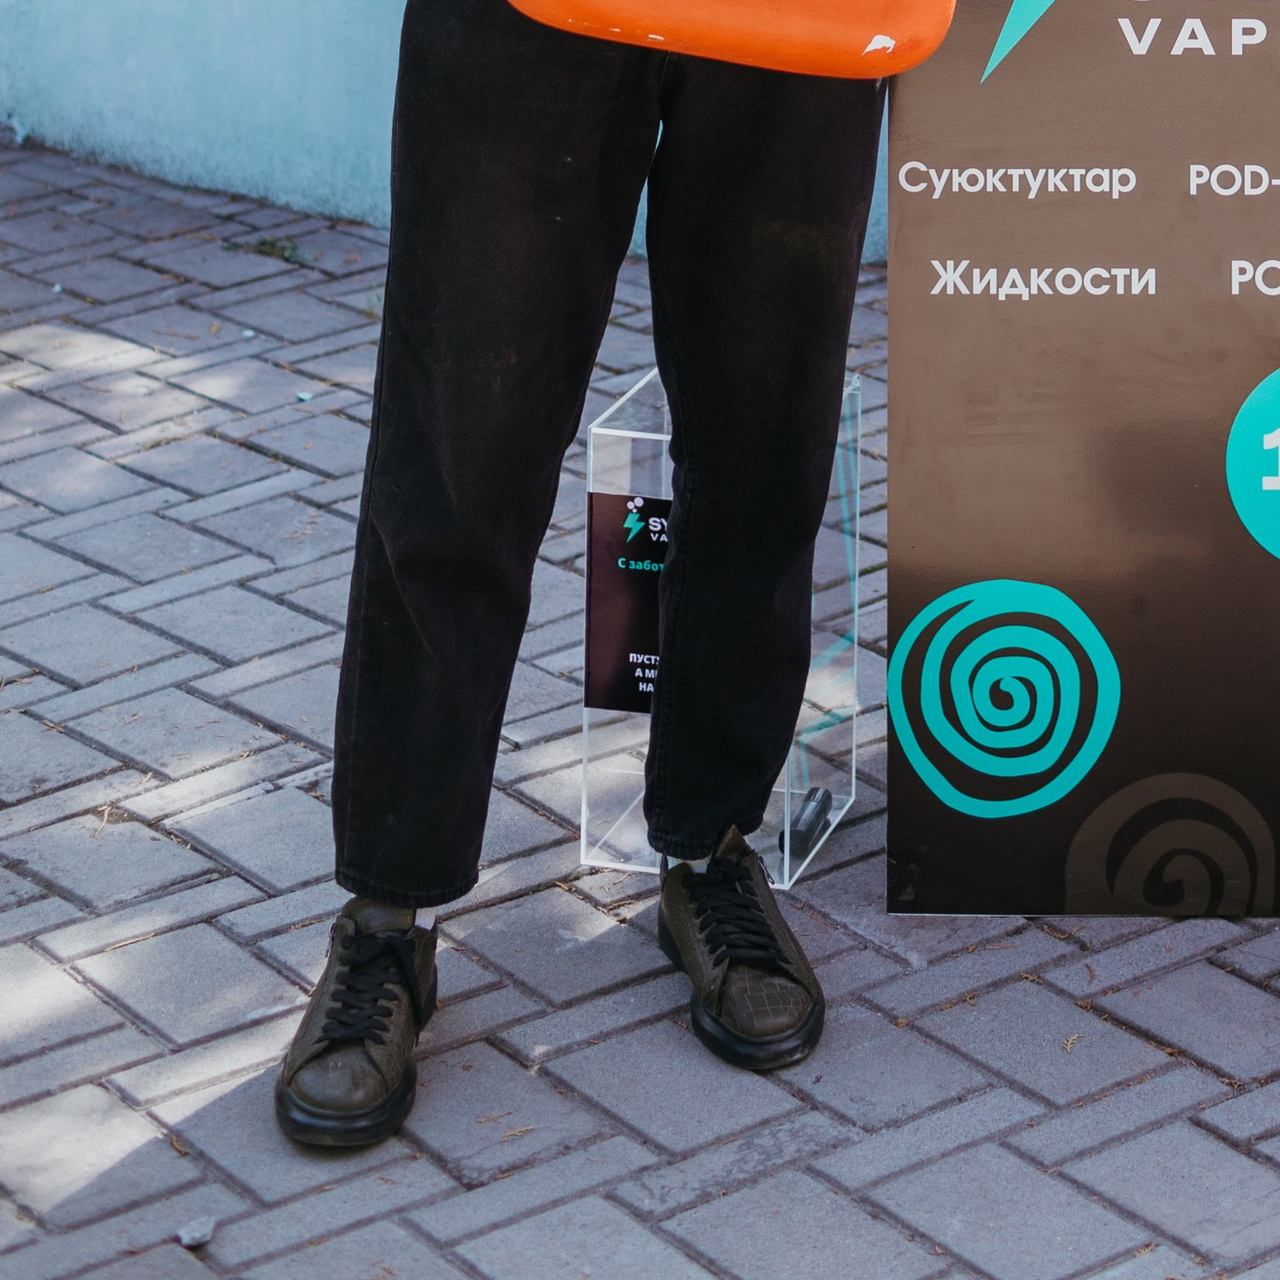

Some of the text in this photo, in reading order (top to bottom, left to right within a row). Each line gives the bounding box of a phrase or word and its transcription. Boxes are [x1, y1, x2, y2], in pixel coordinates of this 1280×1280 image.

[898, 161, 1137, 199] Суюктуктар
[930, 260, 1156, 301] Жидкости
[635, 668, 643, 678] А
